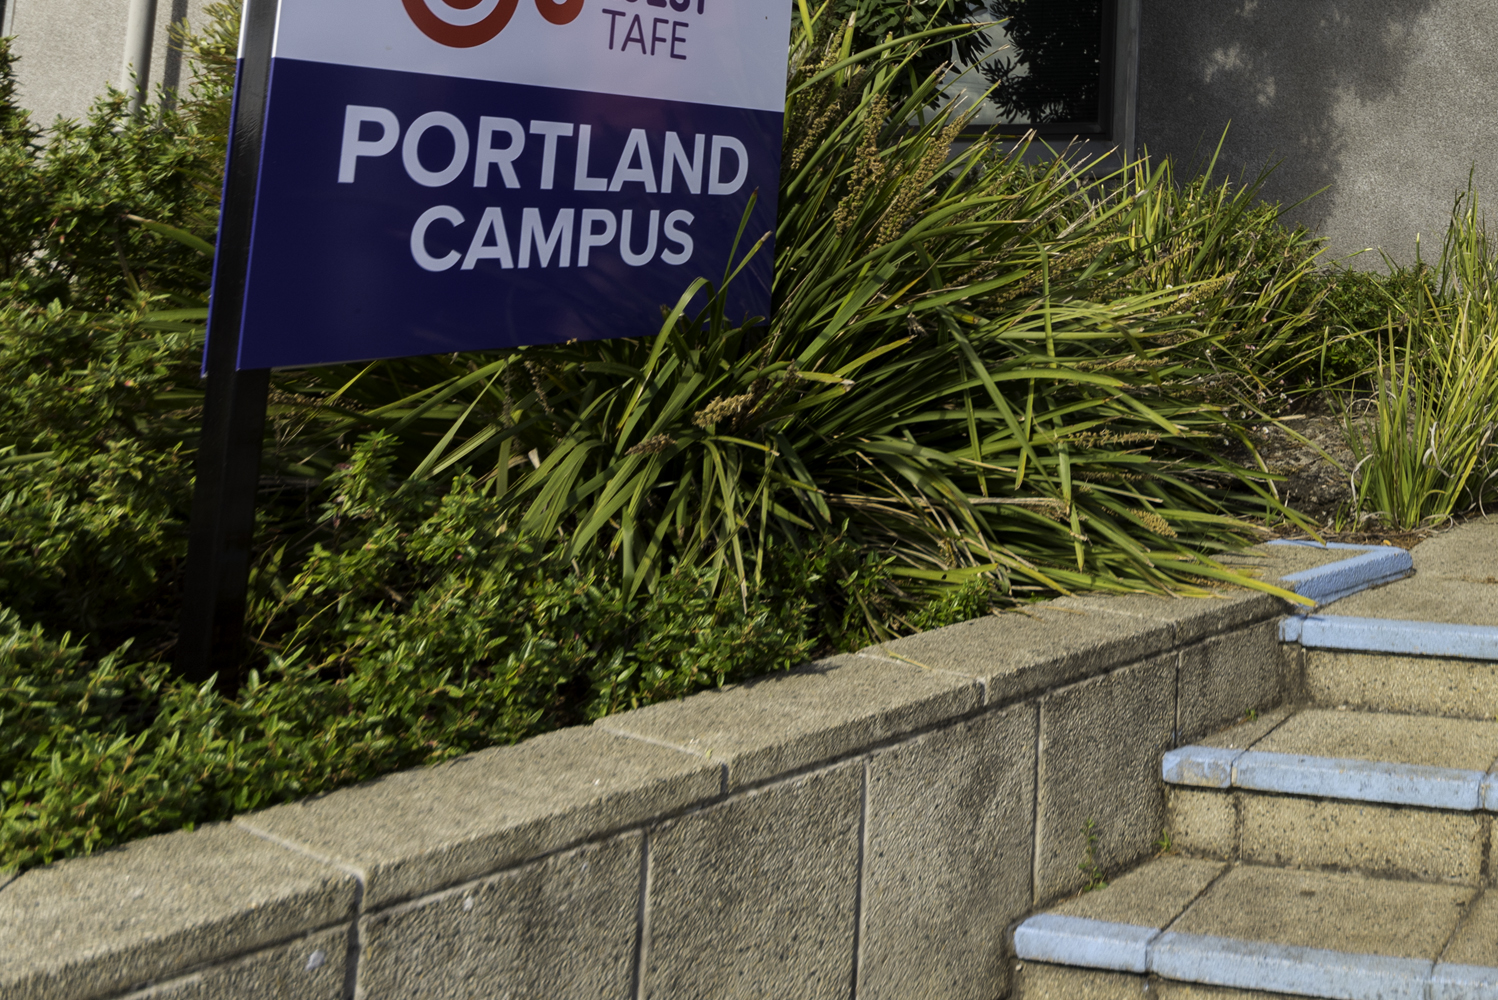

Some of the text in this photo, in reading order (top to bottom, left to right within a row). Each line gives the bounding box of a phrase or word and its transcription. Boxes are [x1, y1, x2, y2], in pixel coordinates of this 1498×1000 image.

[602, 8, 689, 61] TAFE
[337, 104, 749, 196] PORTLAND
[410, 204, 695, 273] CAMPUS
